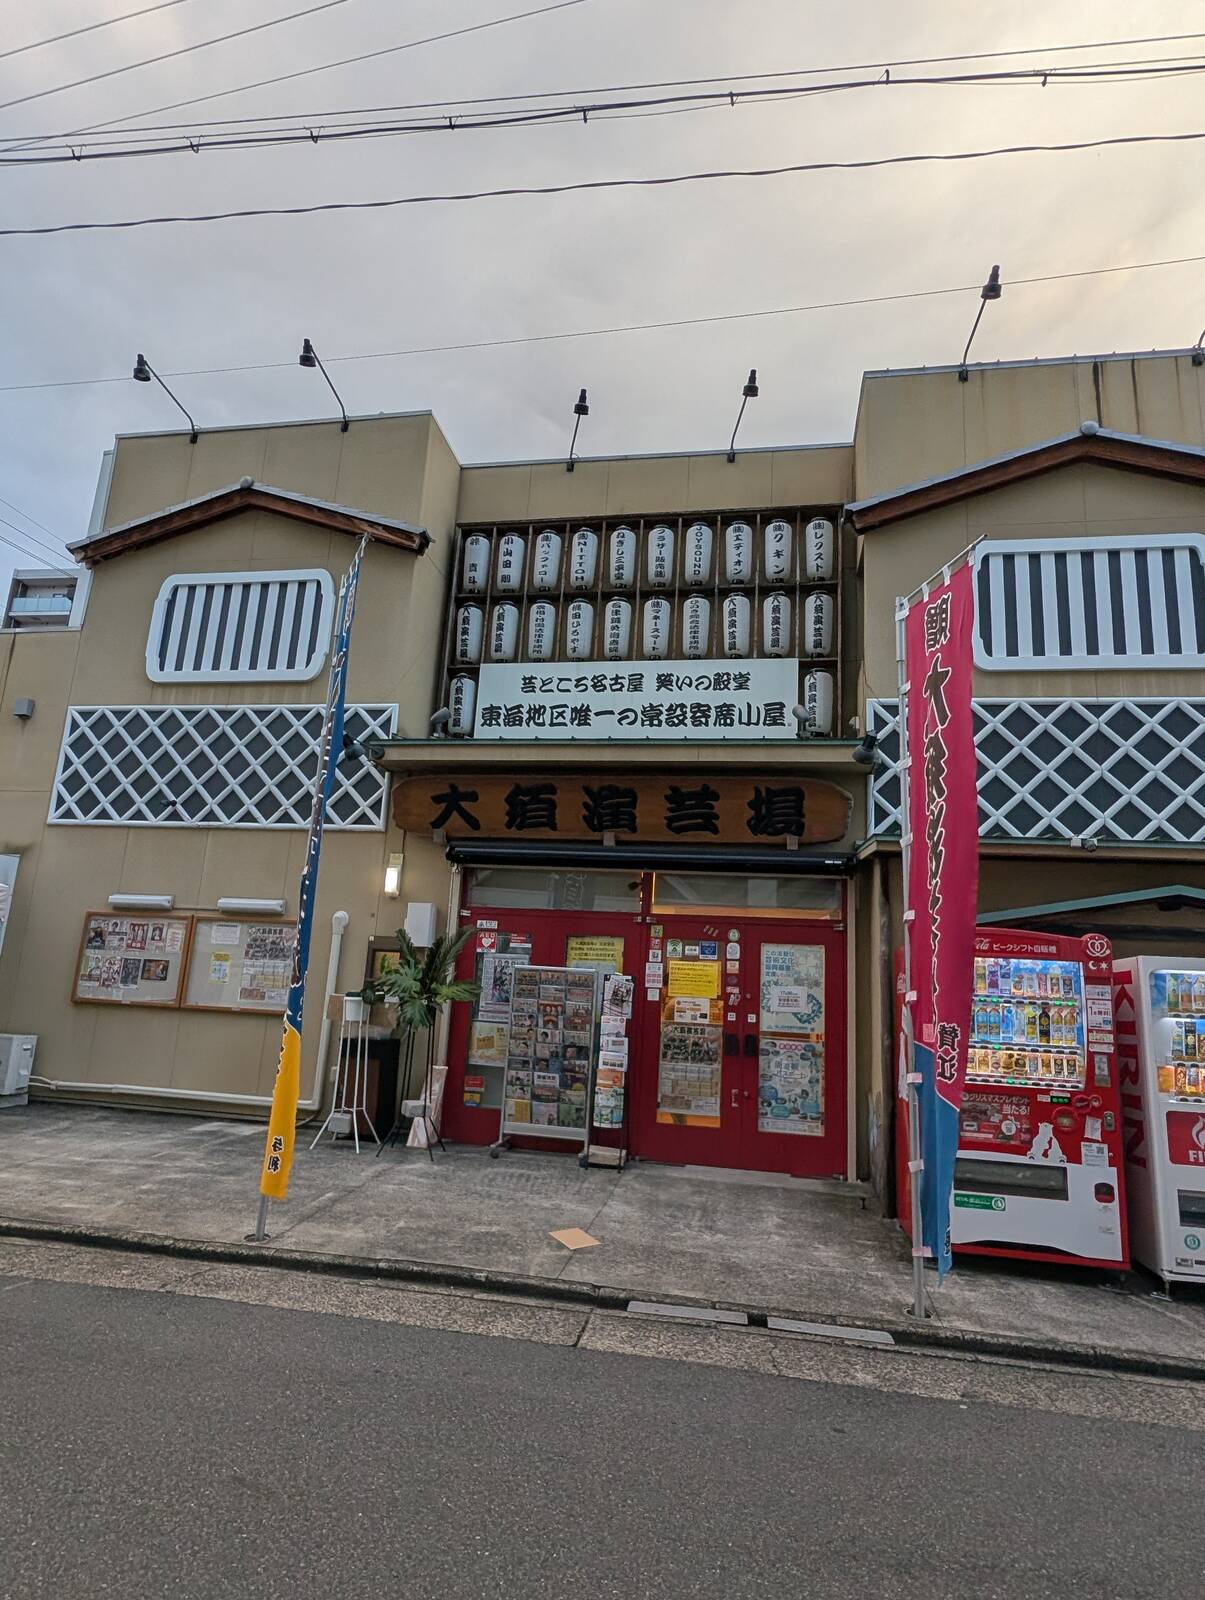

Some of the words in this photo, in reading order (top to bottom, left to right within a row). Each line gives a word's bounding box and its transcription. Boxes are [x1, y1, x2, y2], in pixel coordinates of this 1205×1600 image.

[521, 672, 644, 694] 芸どころ名古屋
[656, 671, 751, 692] 笑いの殿堂
[430, 783, 806, 837] 大須演芸場
[993, 943, 1057, 953] ピークシフト自販機
[1112, 969, 1146, 1169] KIRIN
[1001, 1103, 1030, 1115] 当たる!
